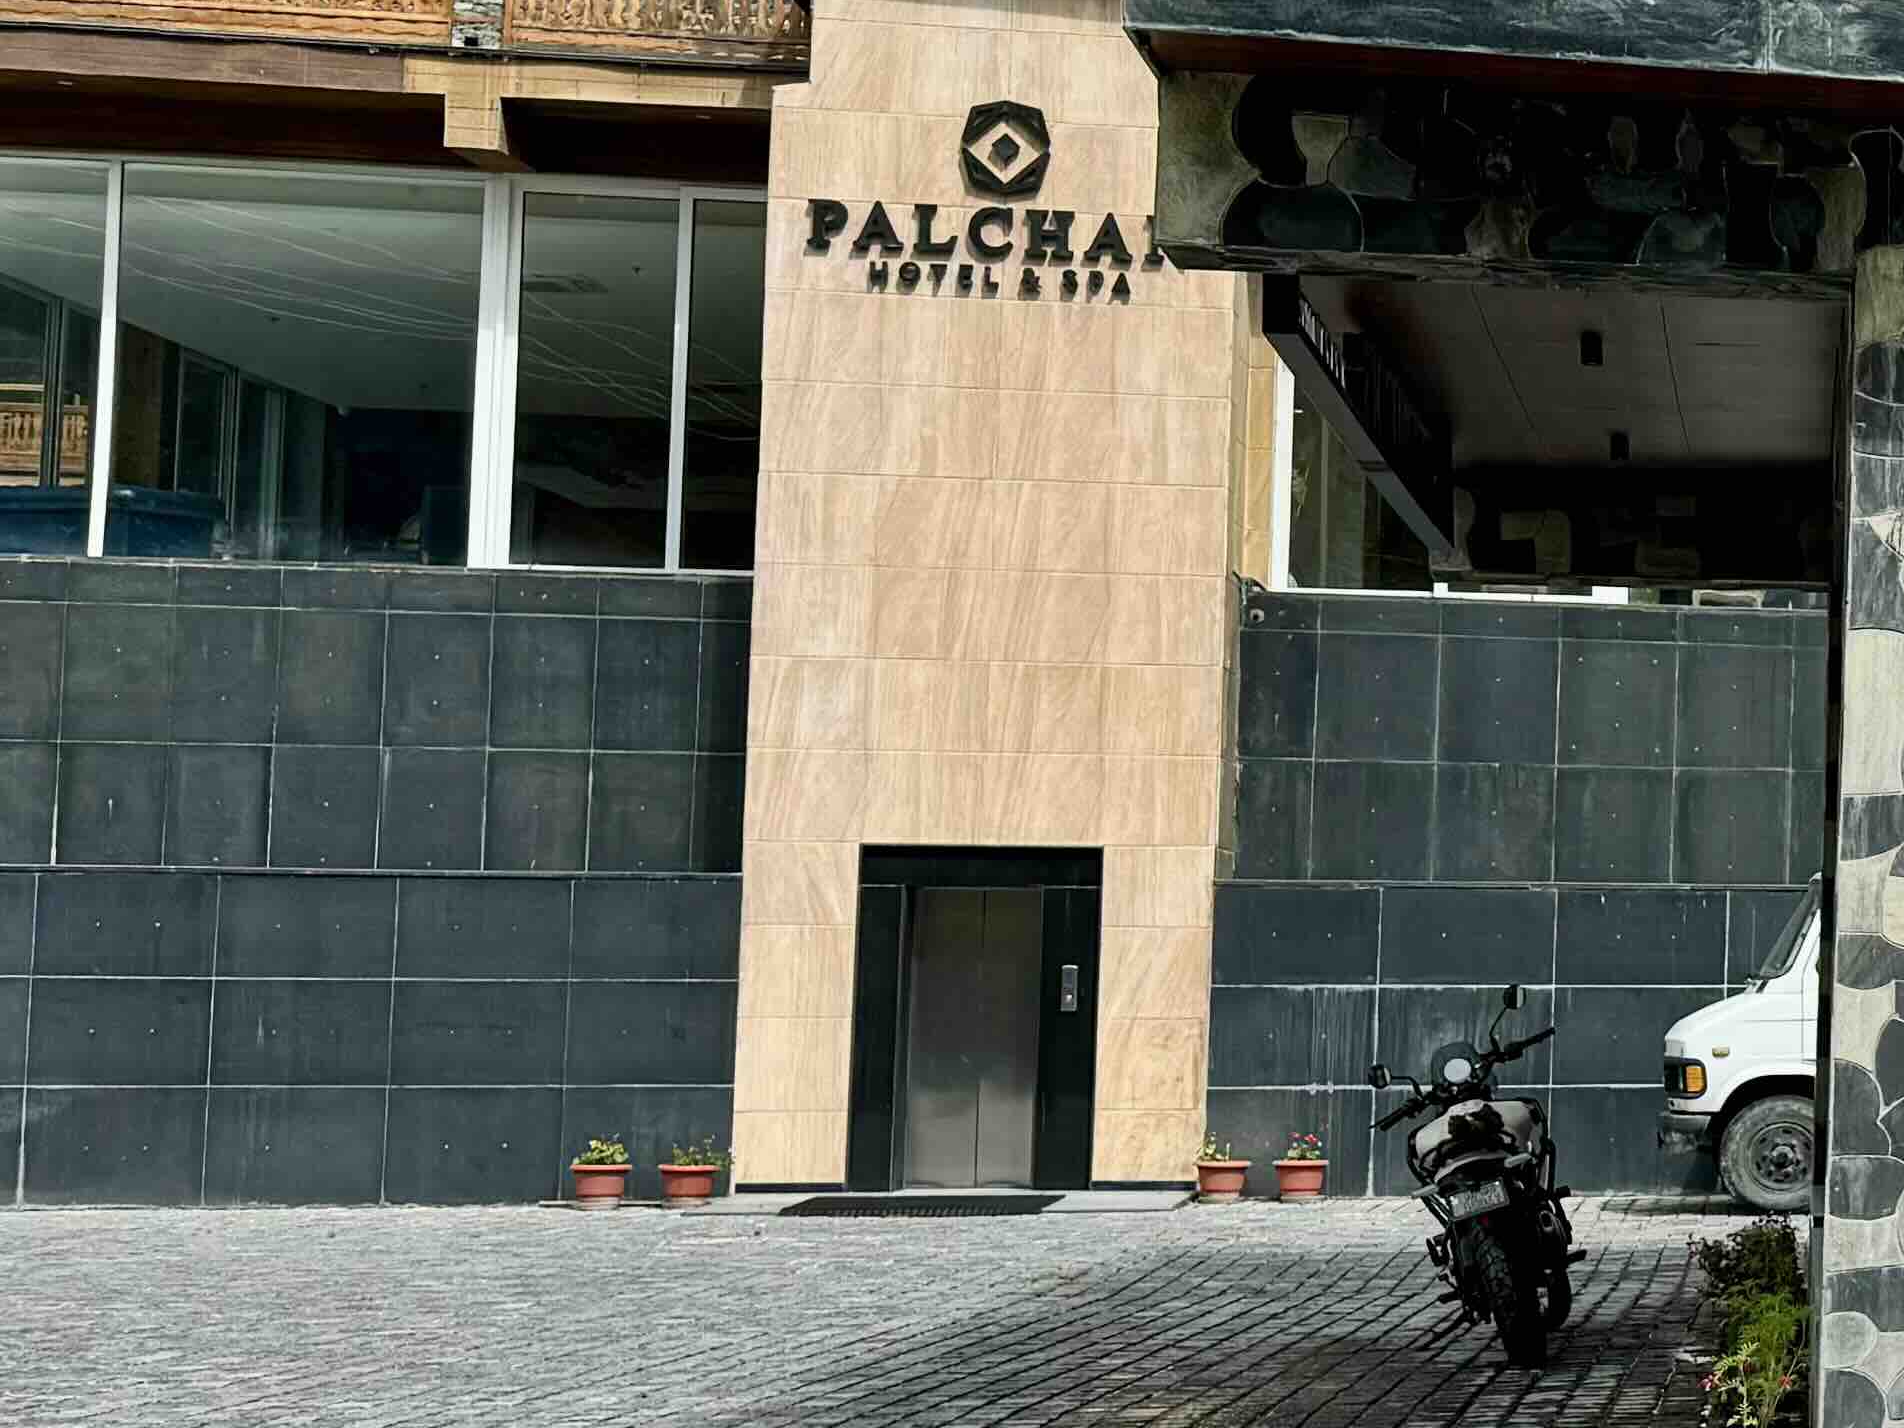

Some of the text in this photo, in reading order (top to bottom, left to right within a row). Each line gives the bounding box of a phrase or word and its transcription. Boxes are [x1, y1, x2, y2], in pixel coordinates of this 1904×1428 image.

[868, 261, 1131, 304] HOTEL & SPA
